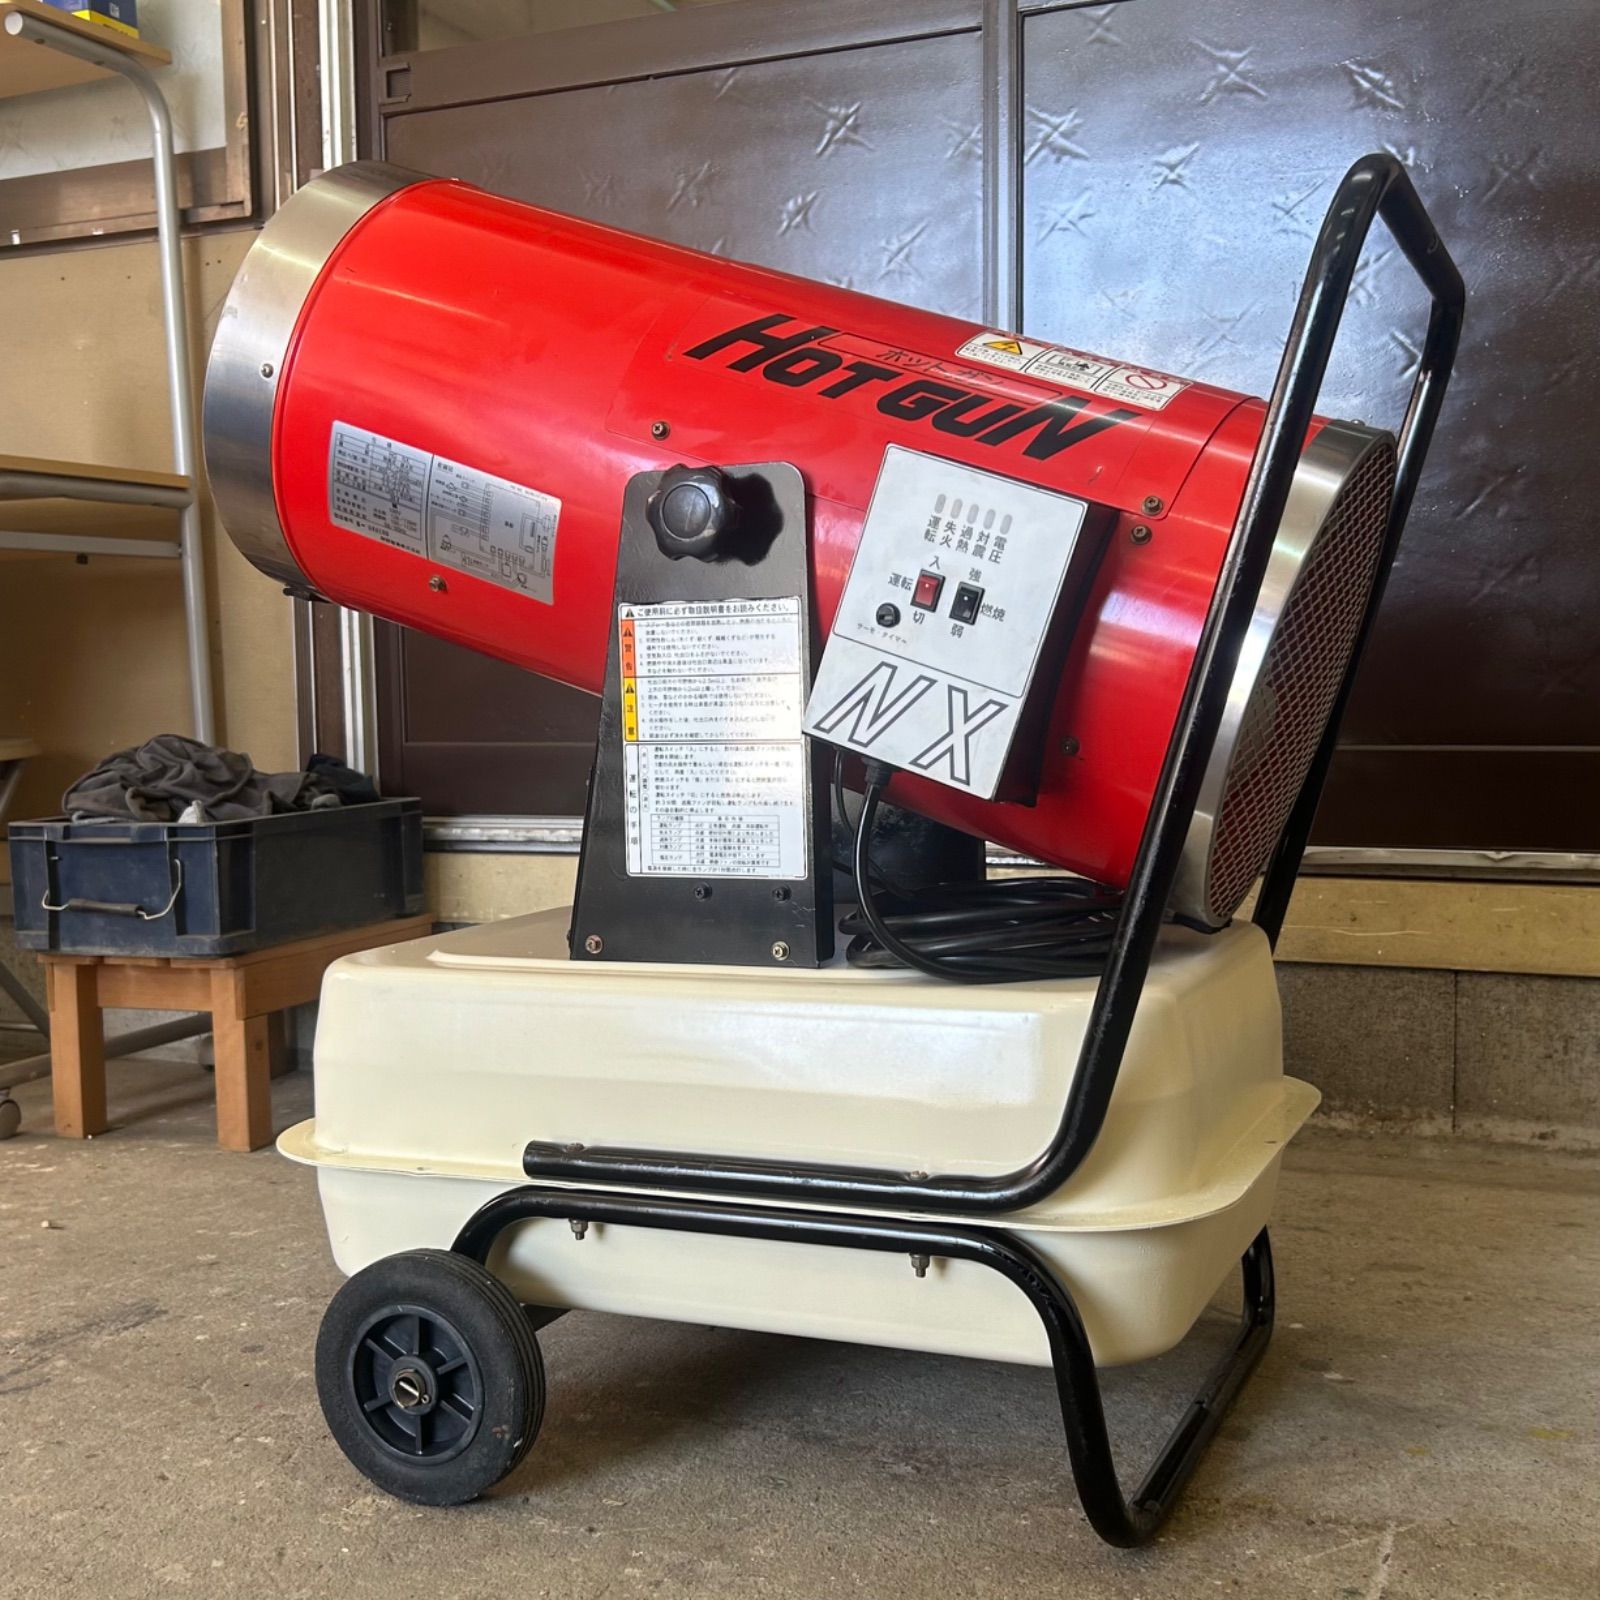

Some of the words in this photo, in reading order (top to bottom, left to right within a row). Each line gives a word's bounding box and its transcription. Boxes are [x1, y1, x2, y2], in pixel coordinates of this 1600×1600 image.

[924, 515, 940, 542] 運転
[940, 521, 957, 549] 失火
[956, 525, 974, 552] 過熱
[972, 530, 990, 560] 対震
[988, 536, 1007, 564] 電圧
[929, 555, 941, 570] 入
[887, 572, 913, 592] 運転
[969, 567, 981, 582] 強
[912, 610, 925, 625] 切
[980, 602, 1005, 622] 燃焼
[950, 624, 964, 639] 弱
[813, 660, 1009, 786] NX
